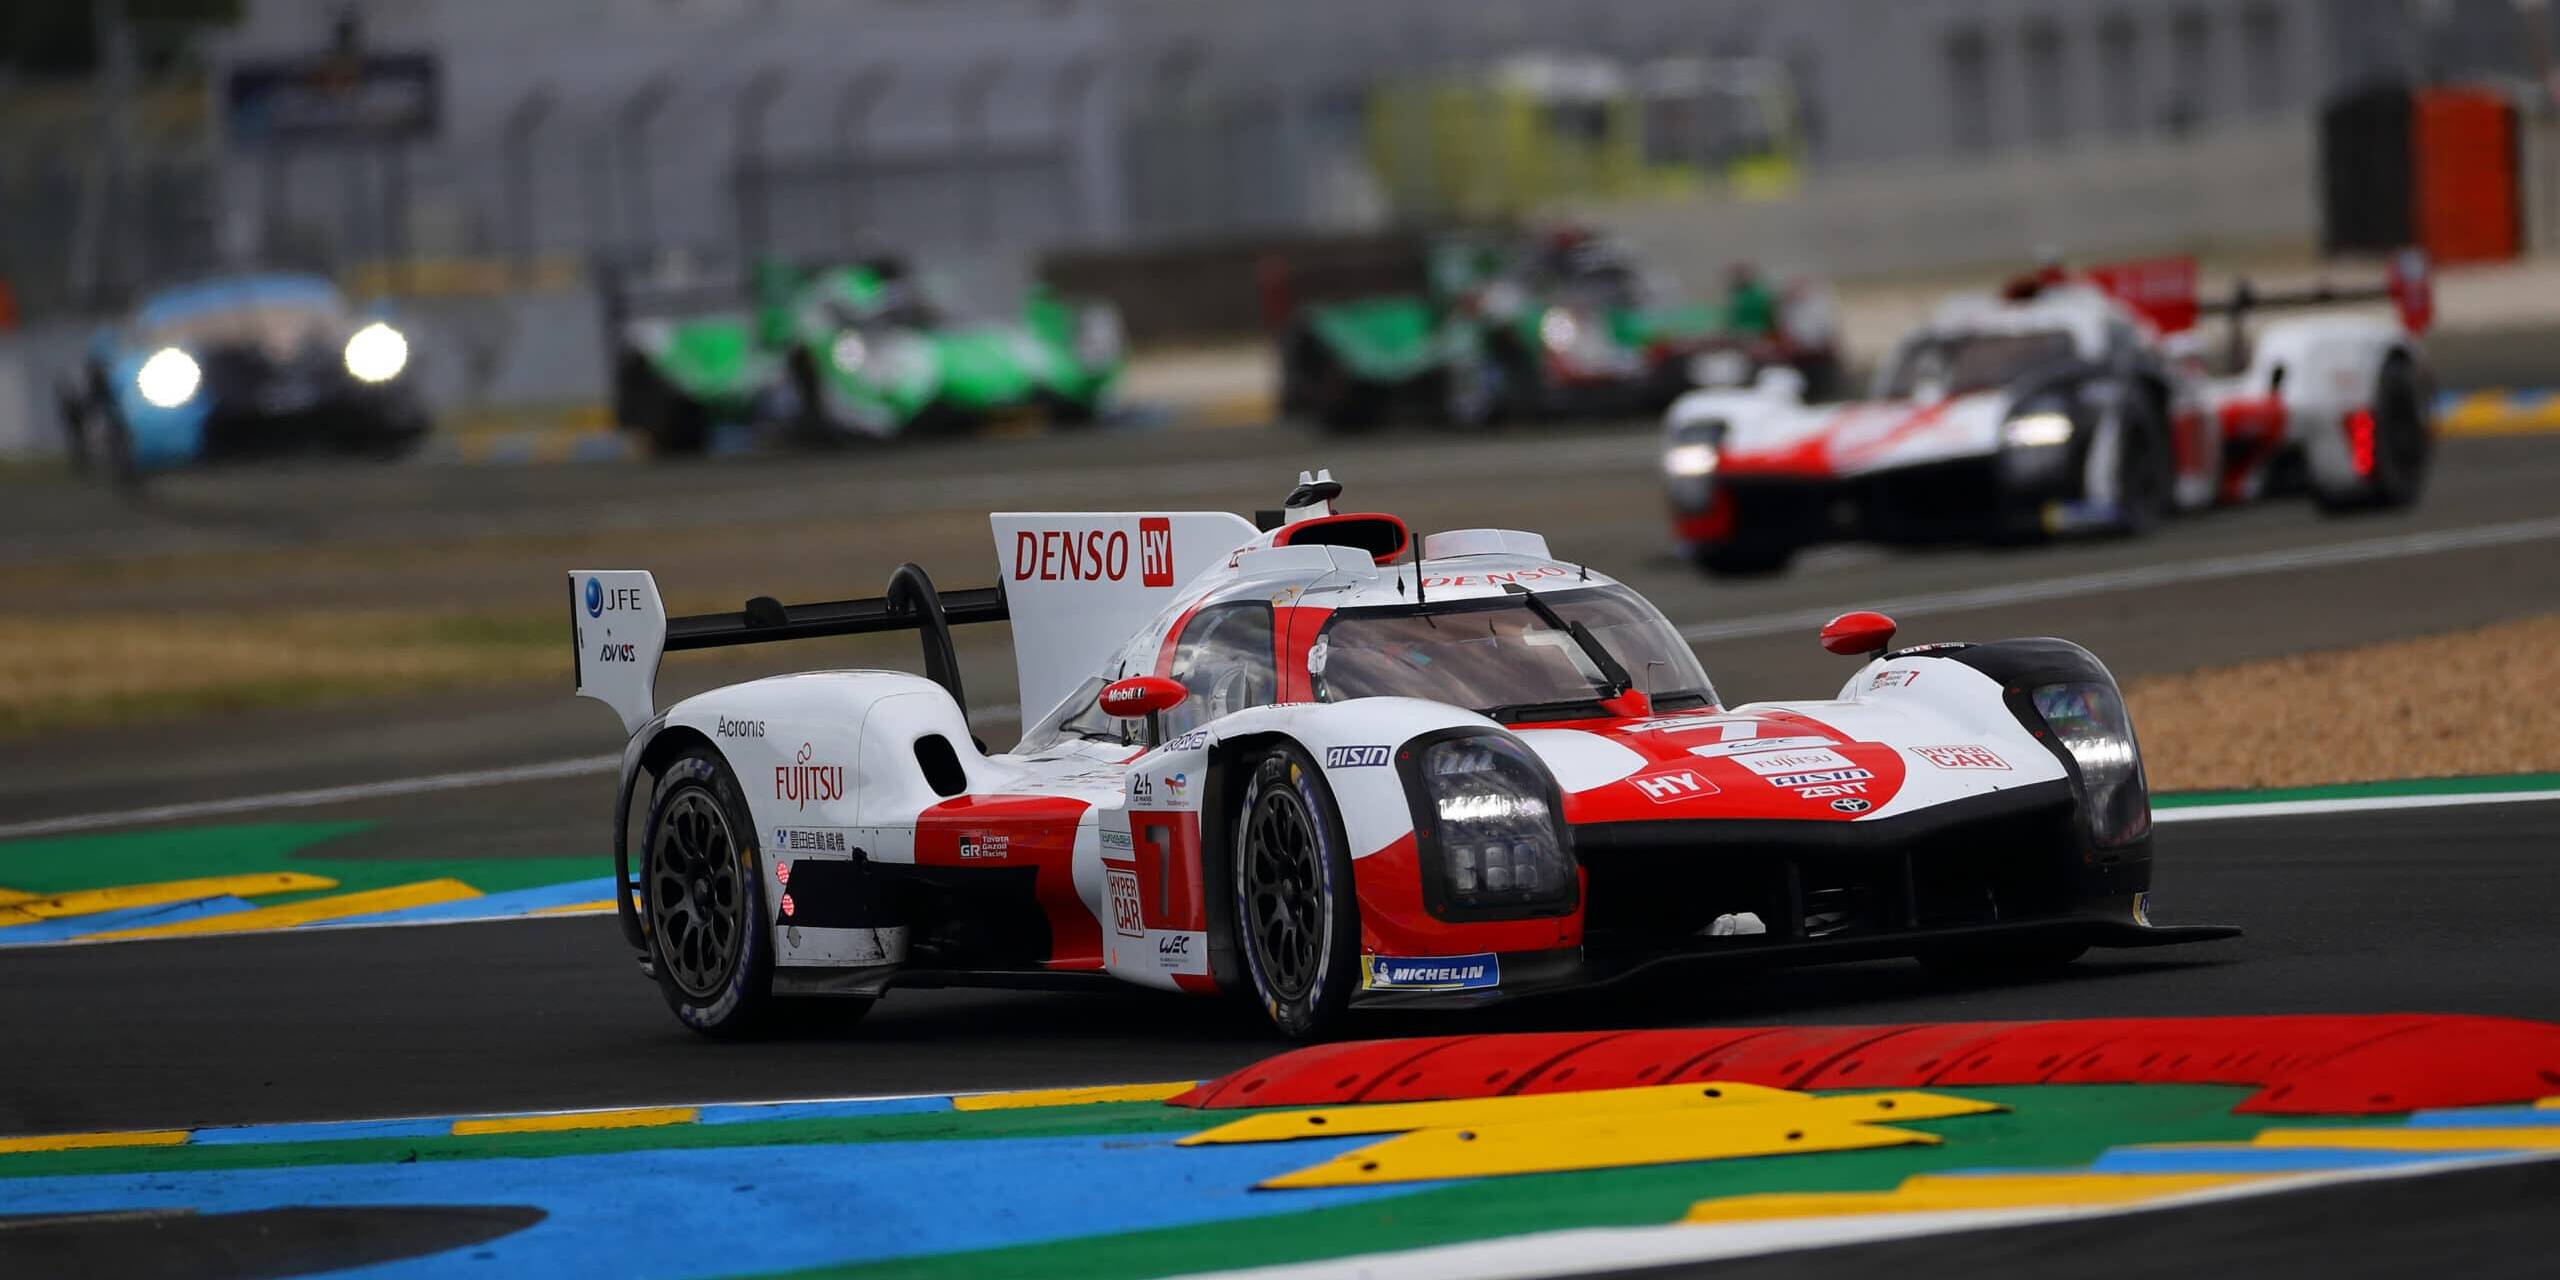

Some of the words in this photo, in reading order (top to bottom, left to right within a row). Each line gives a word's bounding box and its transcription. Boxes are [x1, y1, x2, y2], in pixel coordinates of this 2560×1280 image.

[1015, 530, 1129, 581] DENSO
[1141, 530, 1170, 576] HY
[1421, 565, 1567, 588] DENSO
[606, 588, 642, 611] JFE
[716, 714, 766, 738] Acronis
[1327, 746, 1390, 768] AISIN
[1930, 753, 2005, 767] CAR
[775, 765, 844, 812] FUJITSU
[1636, 772, 1702, 799] HY
[1792, 781, 1869, 799] ZENT
[960, 844, 981, 857] GR
[1109, 875, 1137, 898] HYPER
[1114, 896, 1142, 932] CAR
[1392, 966, 1485, 981] MICHELIN
